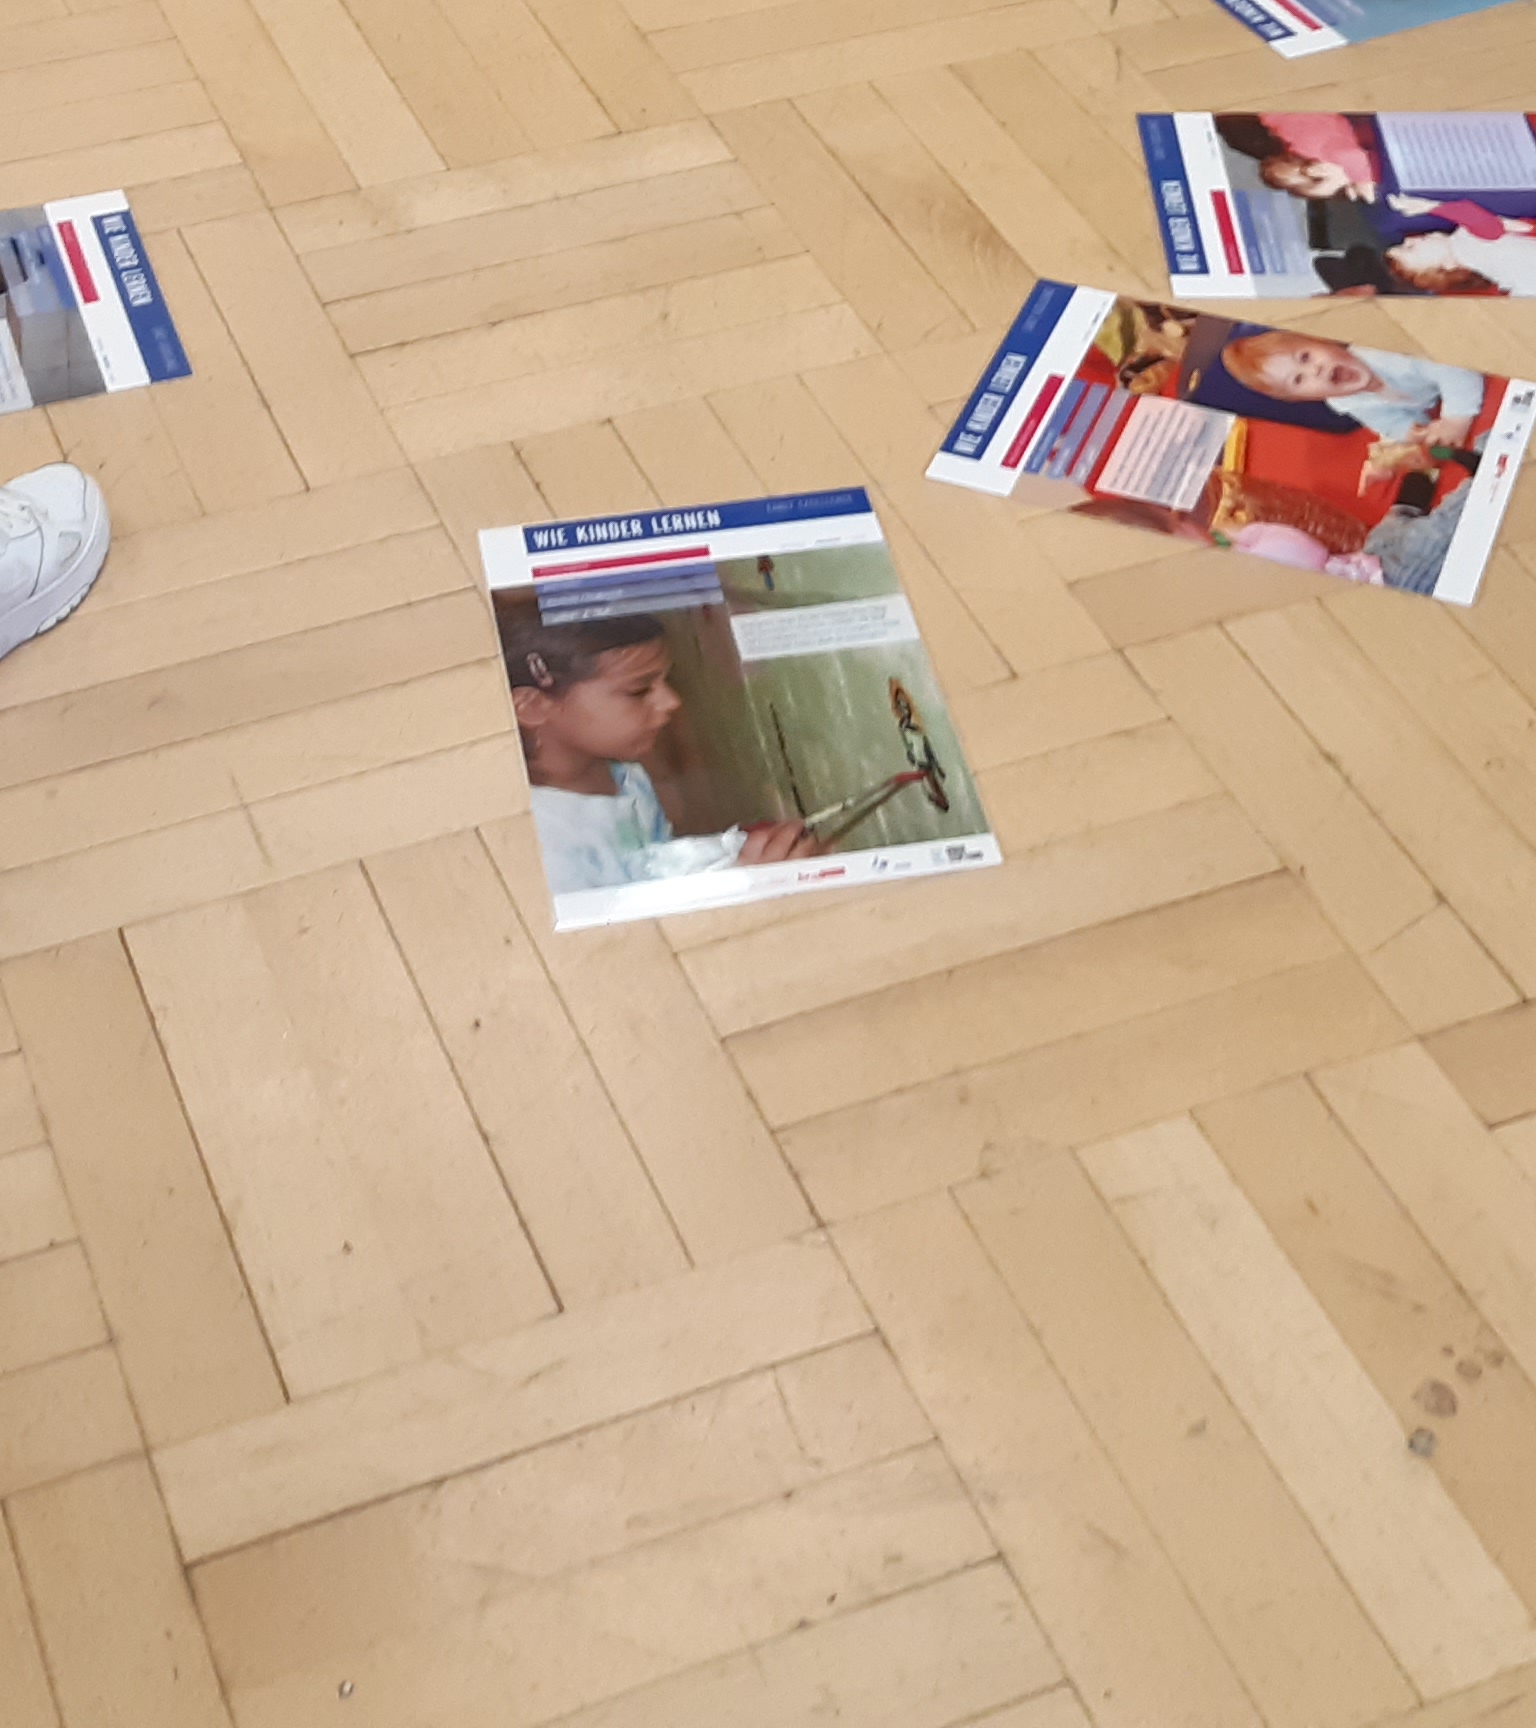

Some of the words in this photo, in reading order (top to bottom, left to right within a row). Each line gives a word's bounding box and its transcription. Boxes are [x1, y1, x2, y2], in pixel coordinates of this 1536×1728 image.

[533, 527, 568, 549] WIE
[576, 519, 643, 544] KINDER
[651, 509, 721, 534] LERNEN
